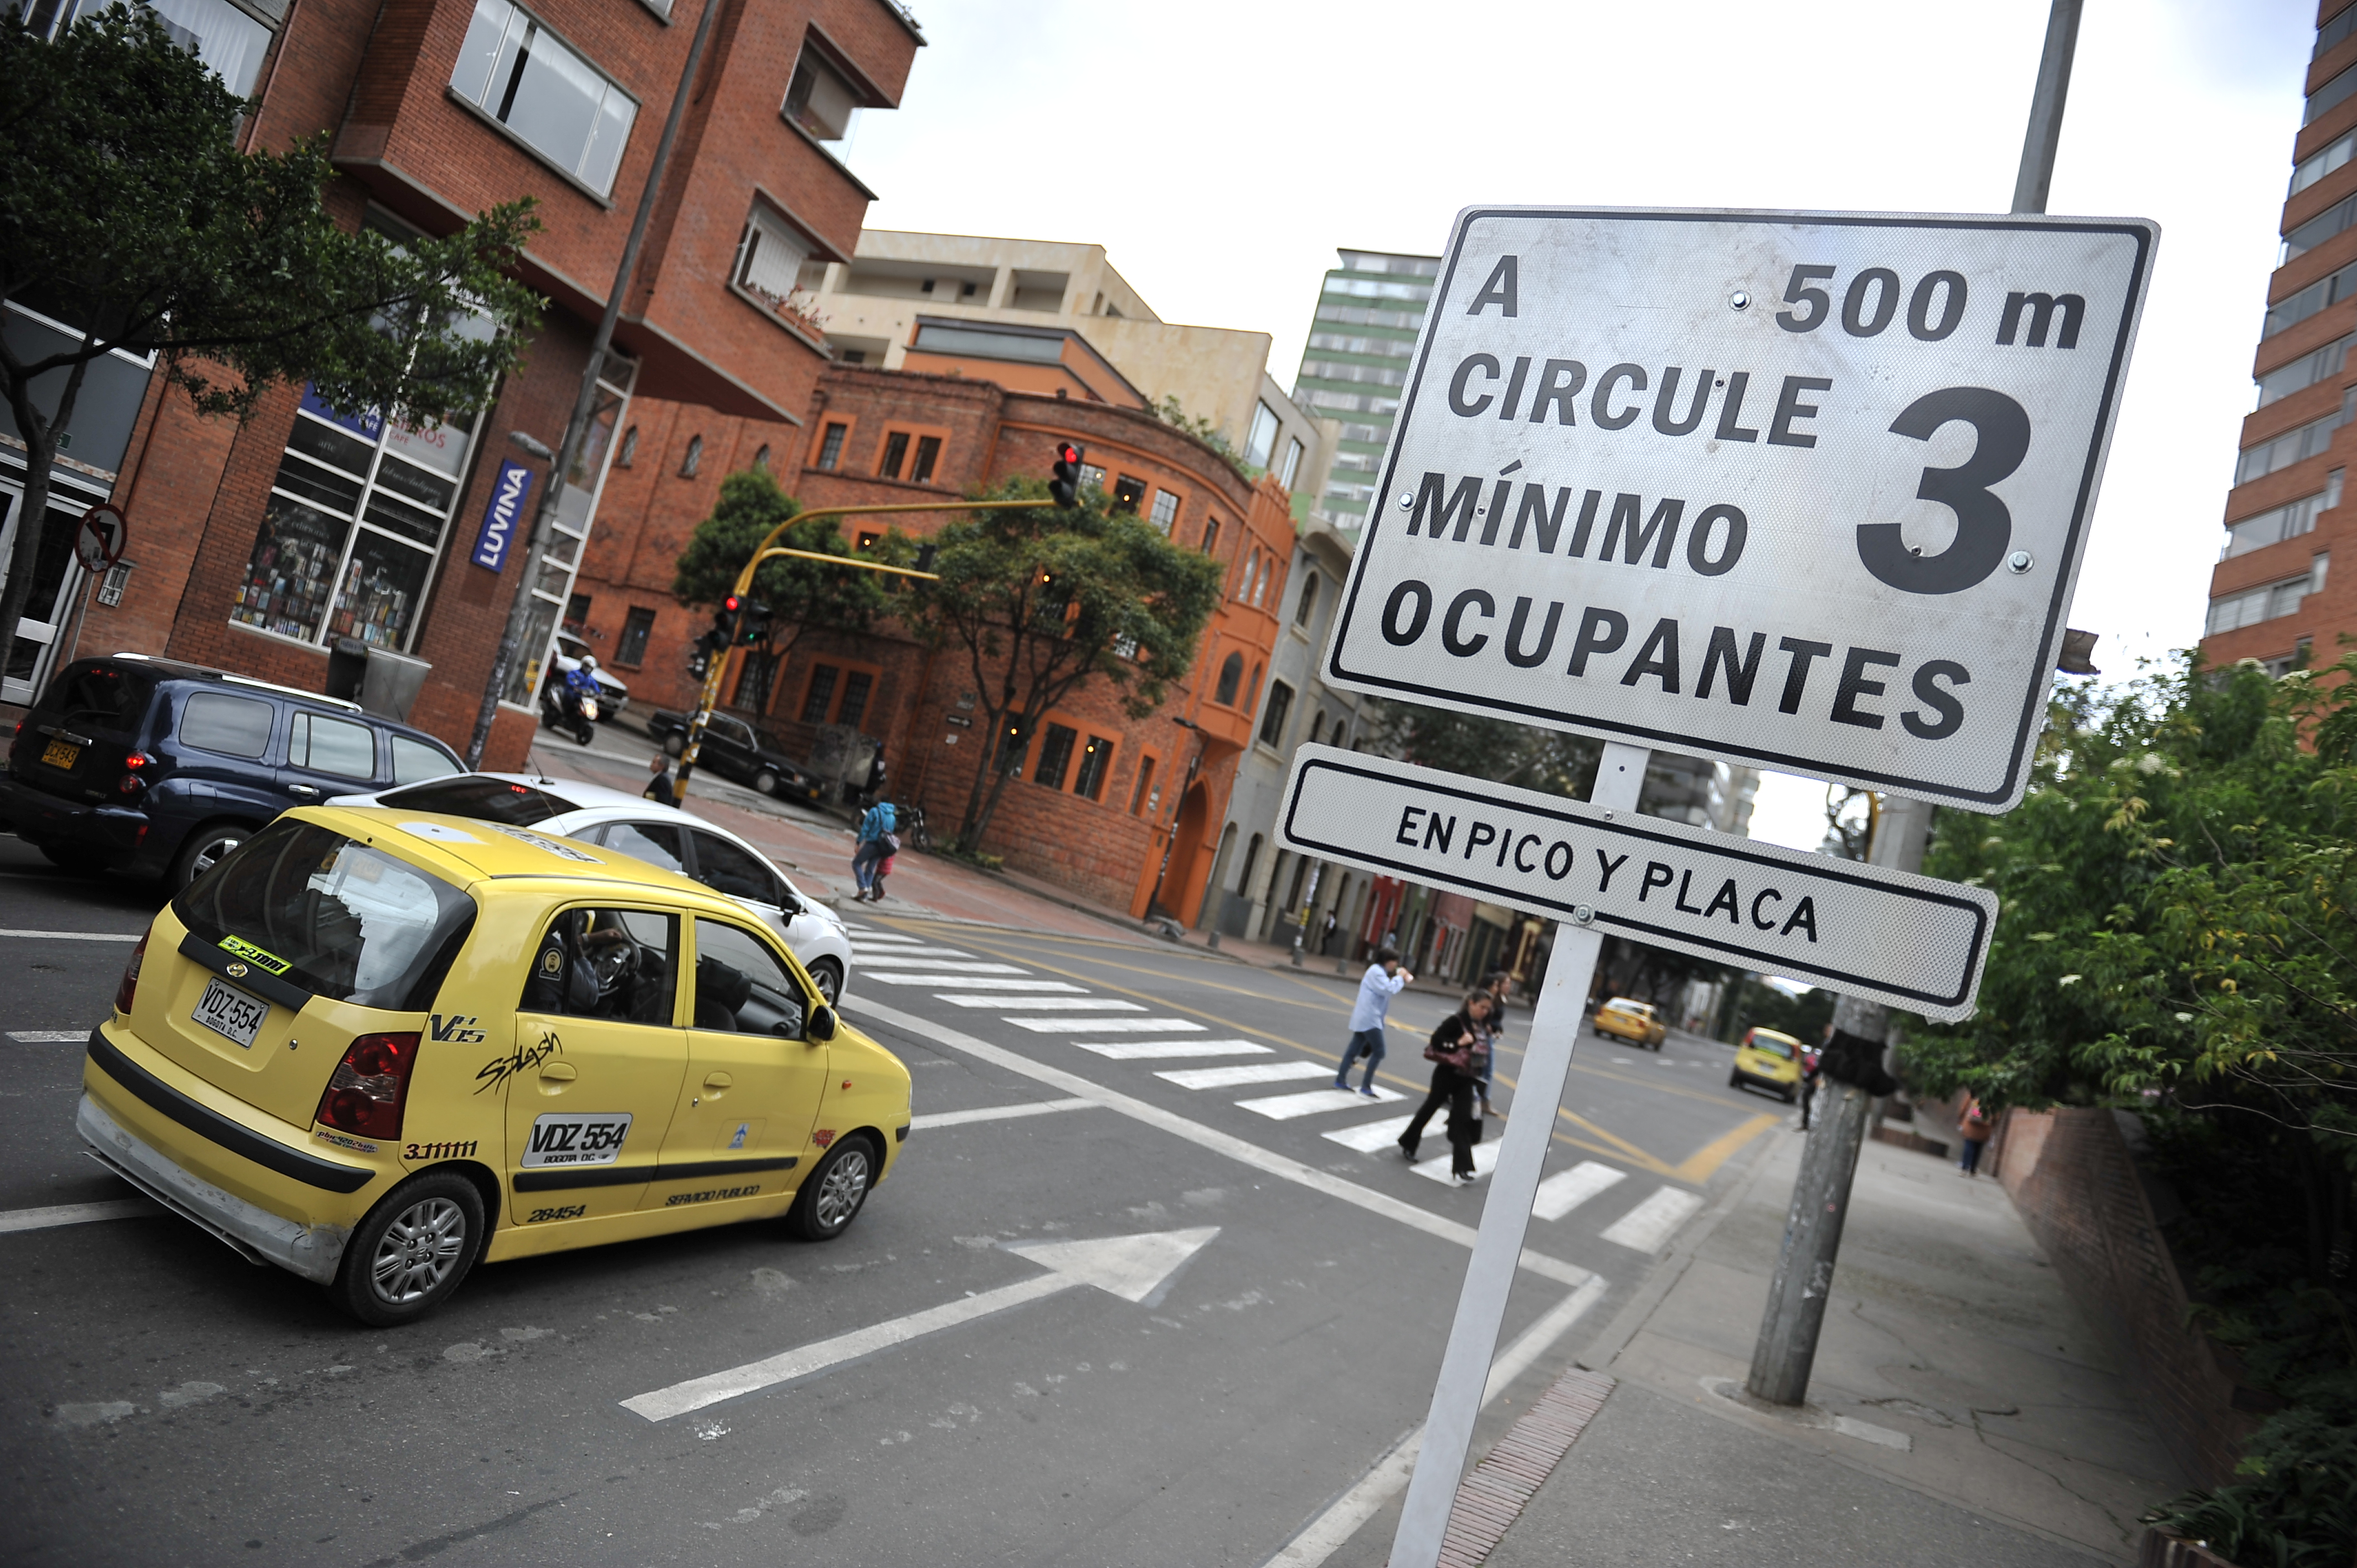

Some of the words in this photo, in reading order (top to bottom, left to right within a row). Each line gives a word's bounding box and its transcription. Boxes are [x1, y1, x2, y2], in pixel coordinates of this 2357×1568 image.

[1468, 255, 1517, 317] A
[1776, 264, 1968, 341] 500
[1995, 291, 2086, 349] m
[1448, 353, 1833, 448] CIRCULE
[480, 470, 527, 567] LUVINA
[1406, 460, 1748, 576] MÍNIMO
[1856, 387, 2031, 595] 3
[1380, 580, 1971, 740] OCUPANTES
[1396, 806, 1457, 854] EN
[1464, 821, 1573, 880] PICO
[1596, 849, 1629, 893] Y
[1638, 860, 1817, 943] PLACA
[202, 984, 235, 1020] VDZ
[229, 999, 263, 1035] 554
[205, 1015, 226, 1031] BOGOTA
[532, 1124, 583, 1153] VDZ
[580, 1123, 628, 1151] 554
[544, 1154, 577, 1163] BOGOTA
[527, 1204, 587, 1223] 28454
[665, 1190, 716, 1206] SERVICIO
[716, 1185, 760, 1200] PUBLICO
